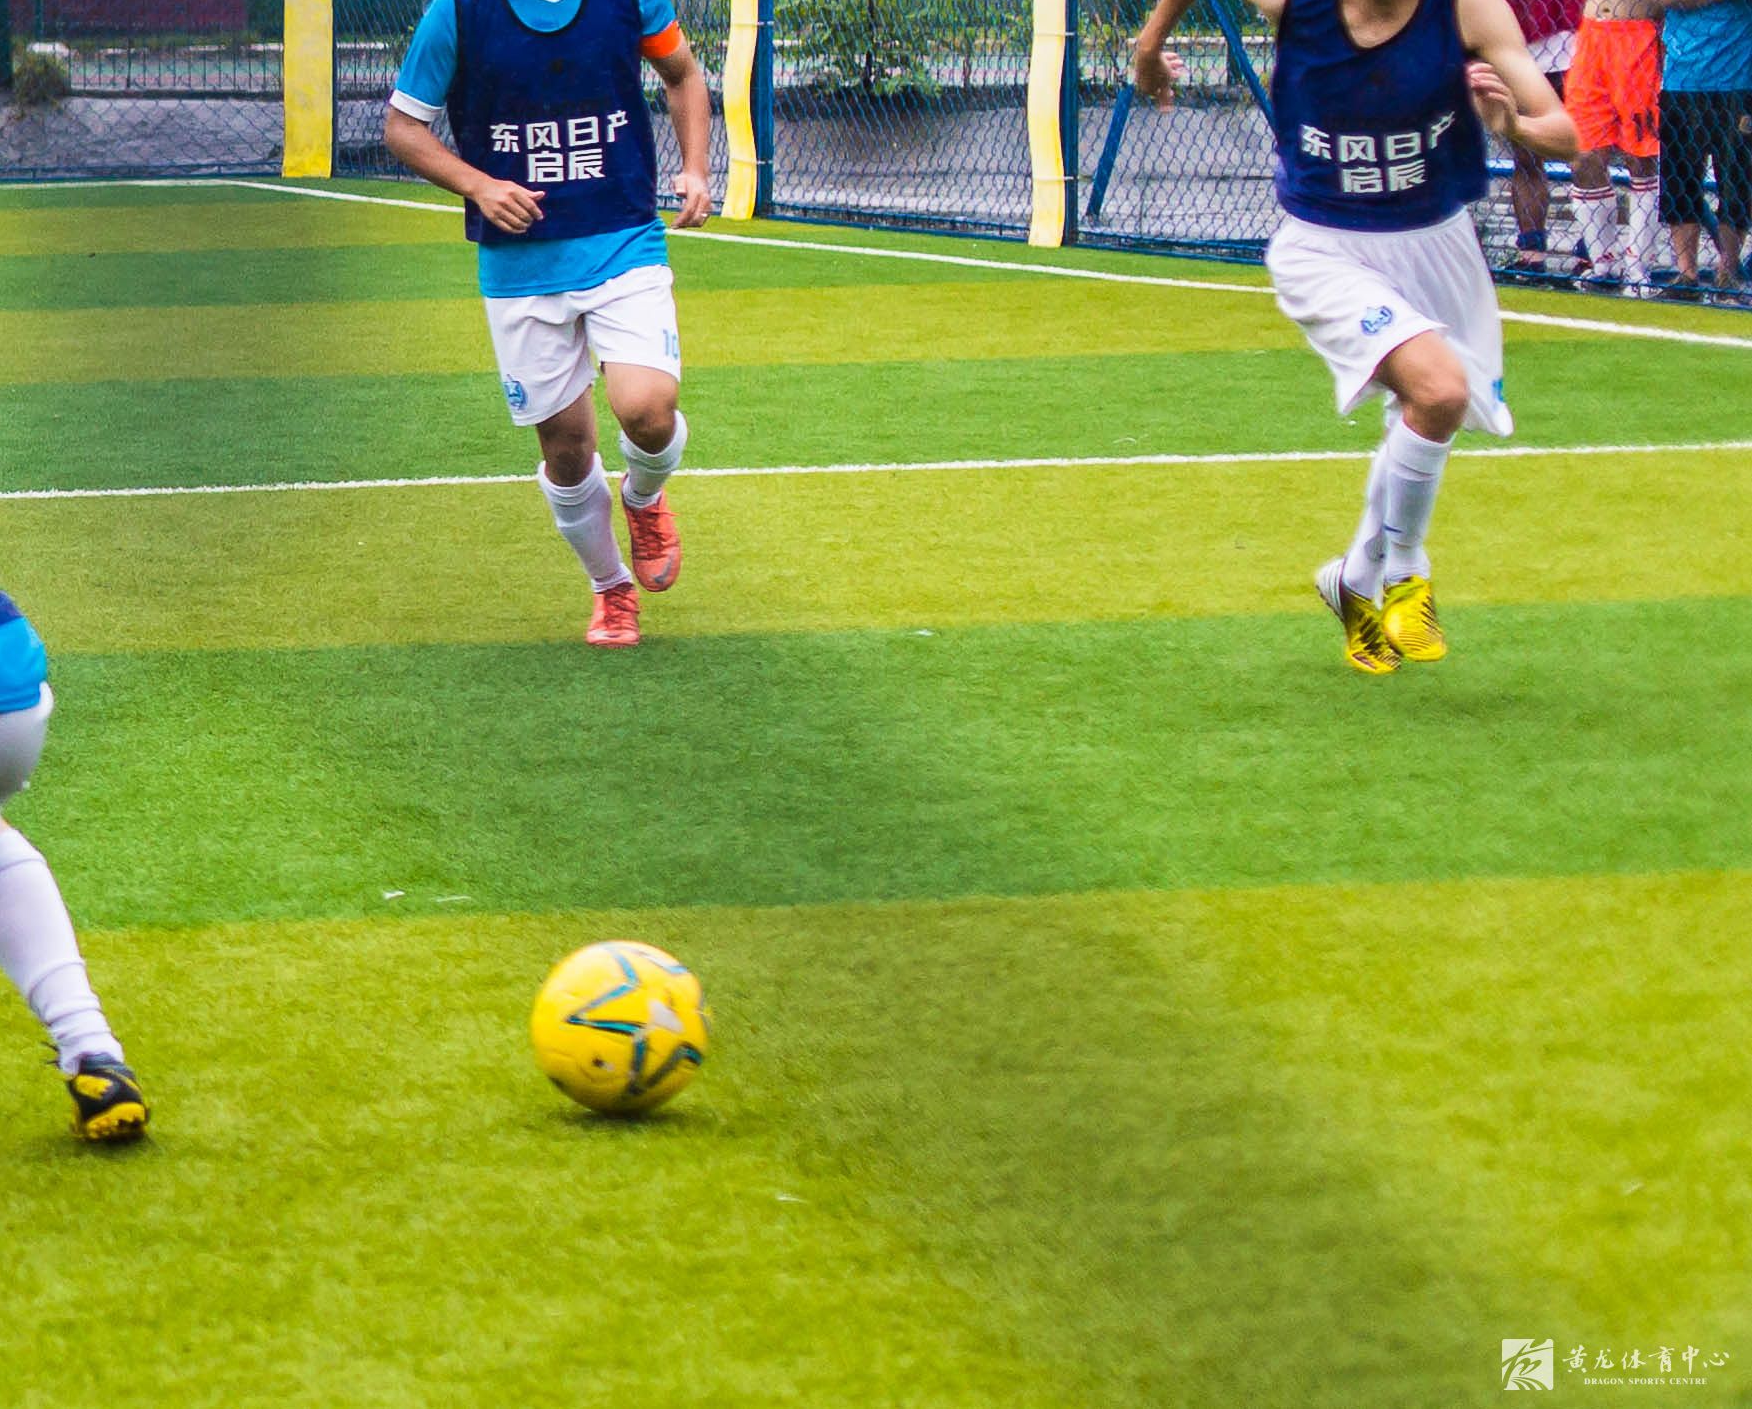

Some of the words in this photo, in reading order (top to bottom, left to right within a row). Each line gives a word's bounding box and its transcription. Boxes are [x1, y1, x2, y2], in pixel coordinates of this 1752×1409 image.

[489, 110, 628, 153] 东风日产
[1300, 111, 1456, 161] 东风日产
[526, 148, 606, 182] 启辰
[1341, 159, 1428, 194] 启辰
